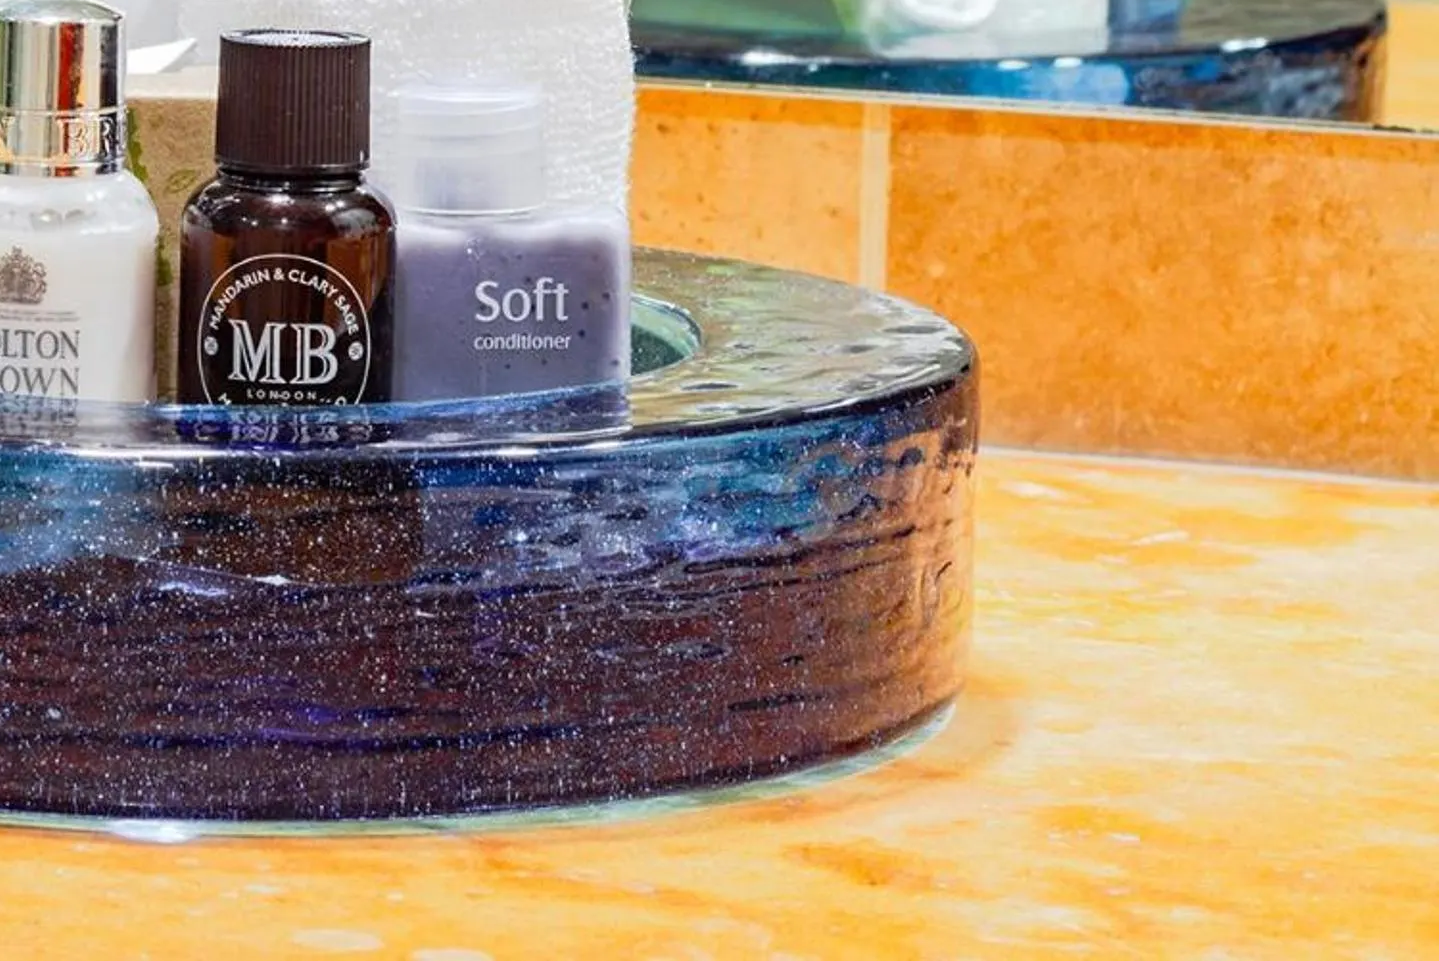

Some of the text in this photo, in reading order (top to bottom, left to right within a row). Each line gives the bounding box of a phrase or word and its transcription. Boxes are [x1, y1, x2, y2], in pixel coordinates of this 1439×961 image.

[210, 267, 359, 336] MANDARIN & CLARY SAGE
[475, 277, 569, 322] Soft
[227, 319, 339, 385] MB
[474, 333, 572, 351] conditioner
[246, 389, 317, 401] LONDON
